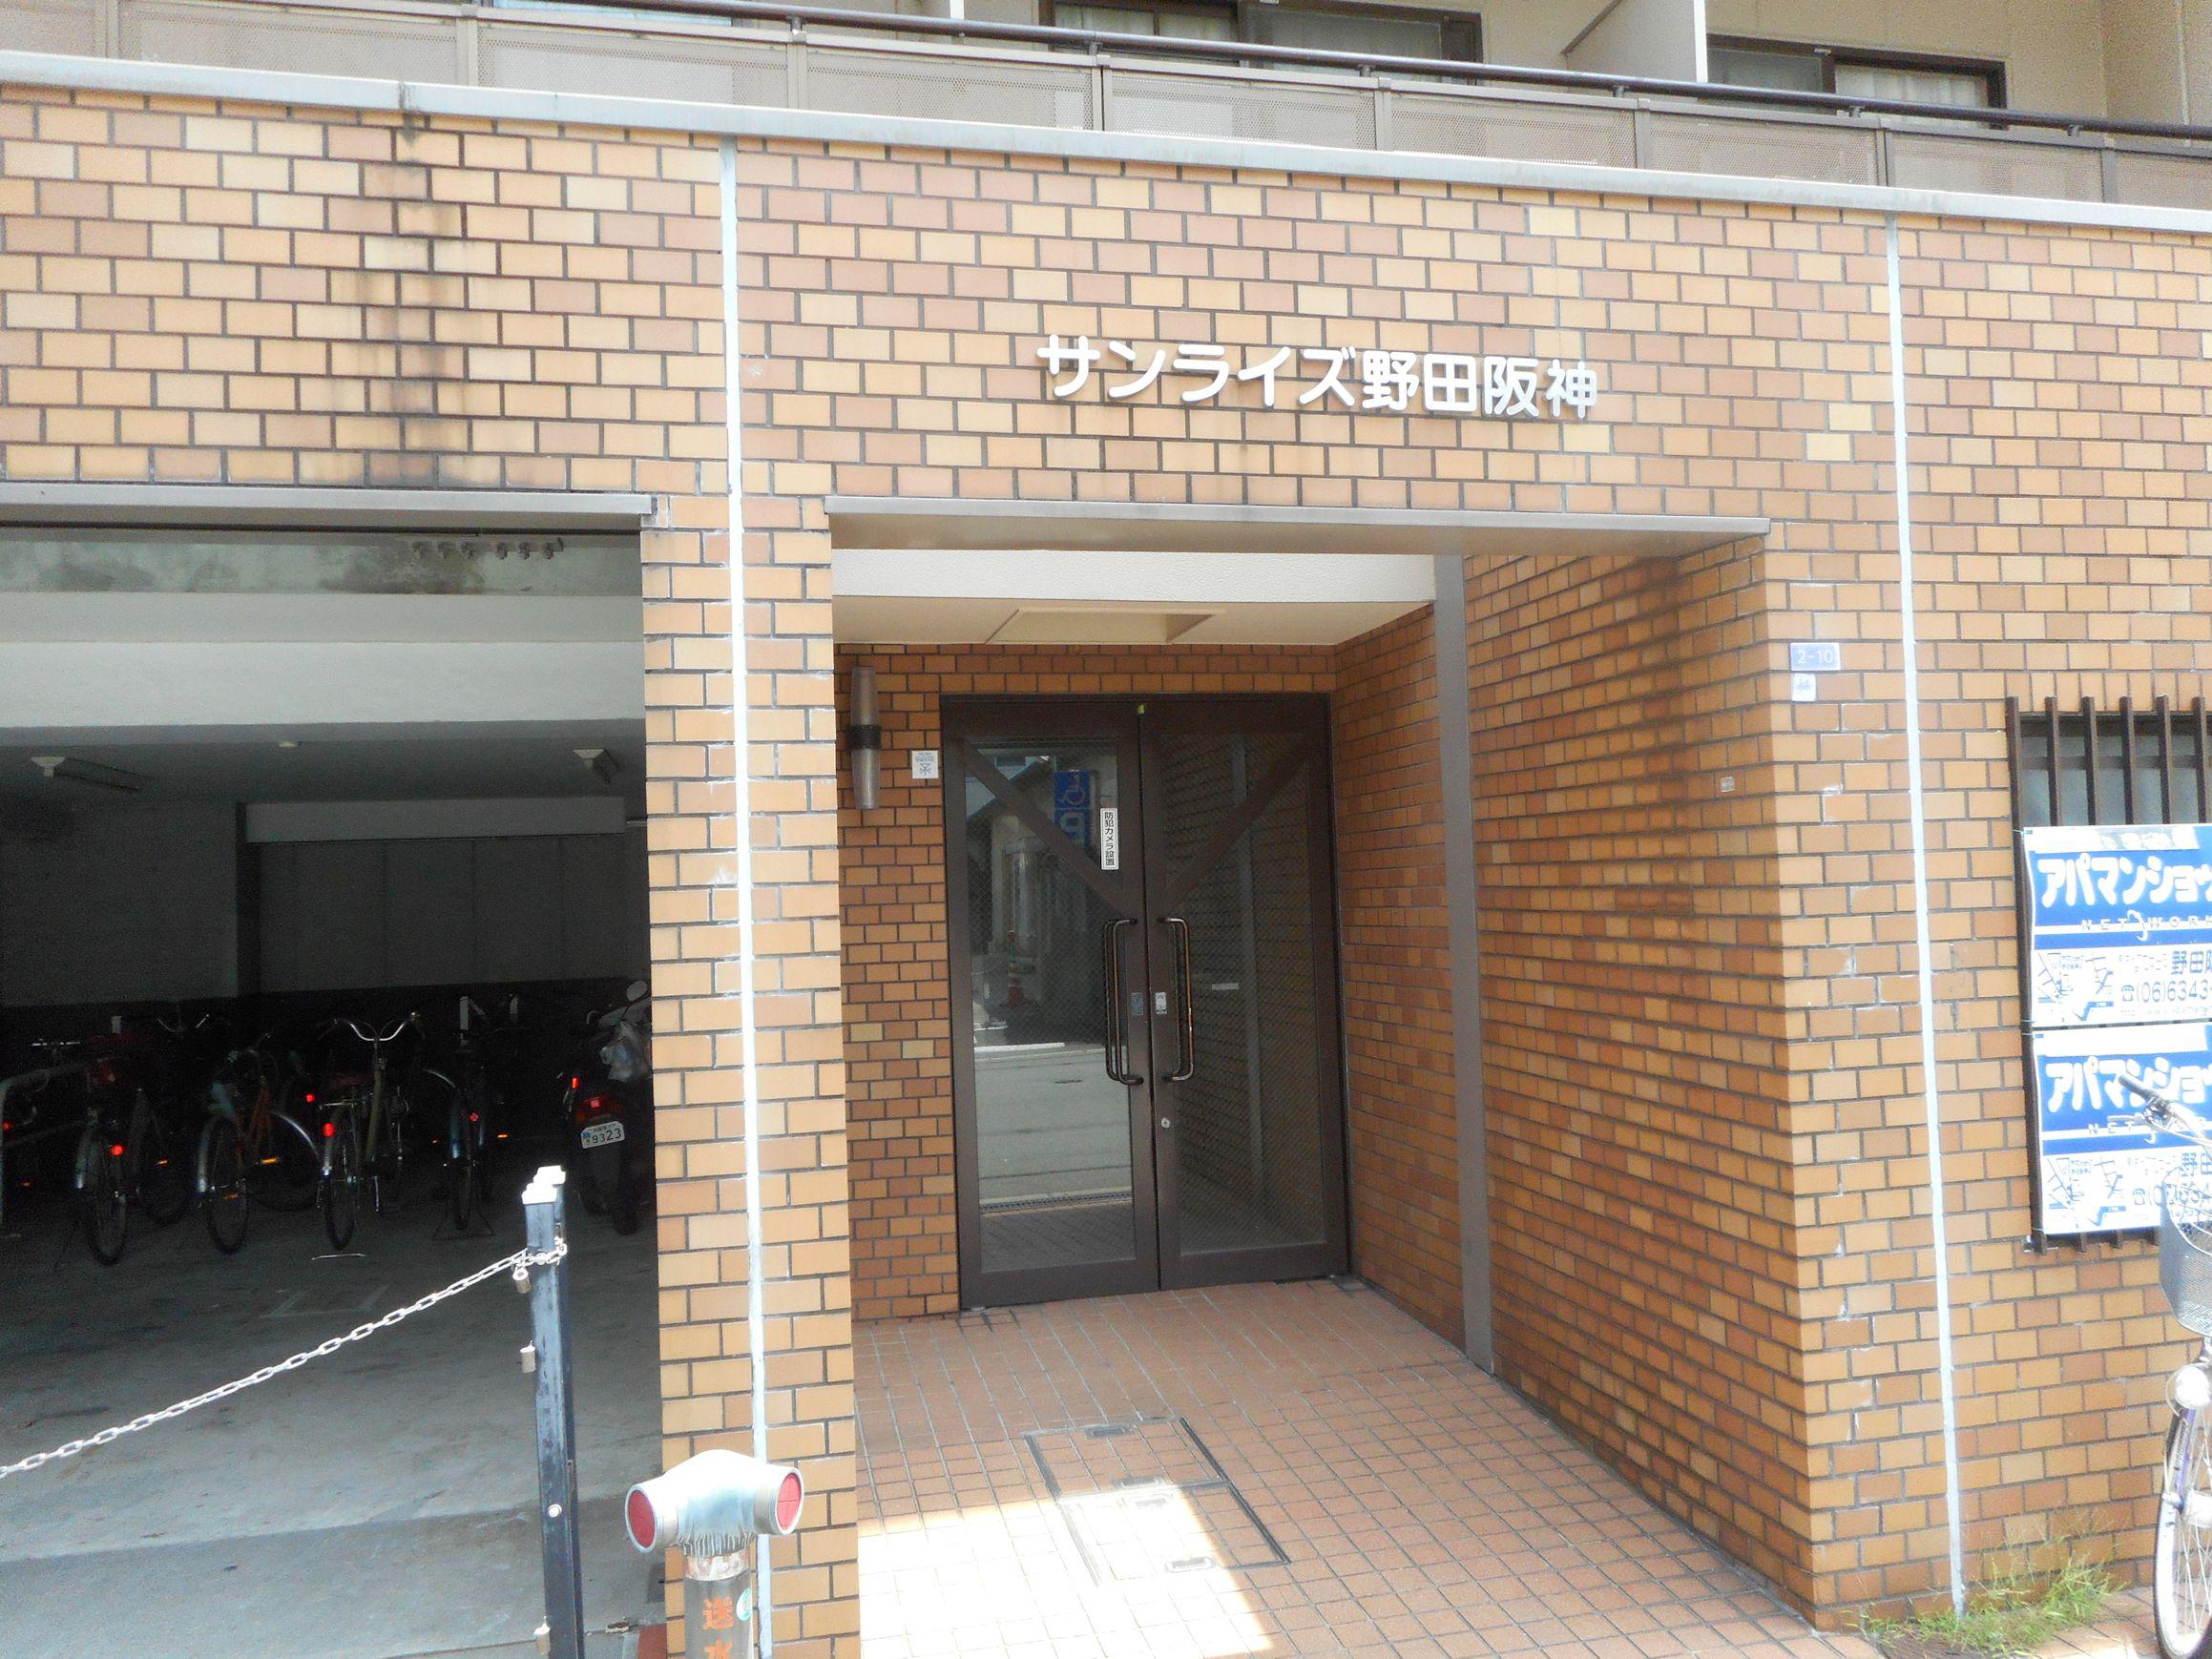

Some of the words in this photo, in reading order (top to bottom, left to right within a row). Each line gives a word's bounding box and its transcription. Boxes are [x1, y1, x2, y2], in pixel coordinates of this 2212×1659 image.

[1037, 334, 1597, 419] サンライズ野田阪神
[1797, 649, 1833, 664] 2-10
[1104, 811, 1116, 866] 防犯カメラ設置
[2137, 979, 2212, 1003] (06)6343
[592, 1128, 622, 1144] 9323
